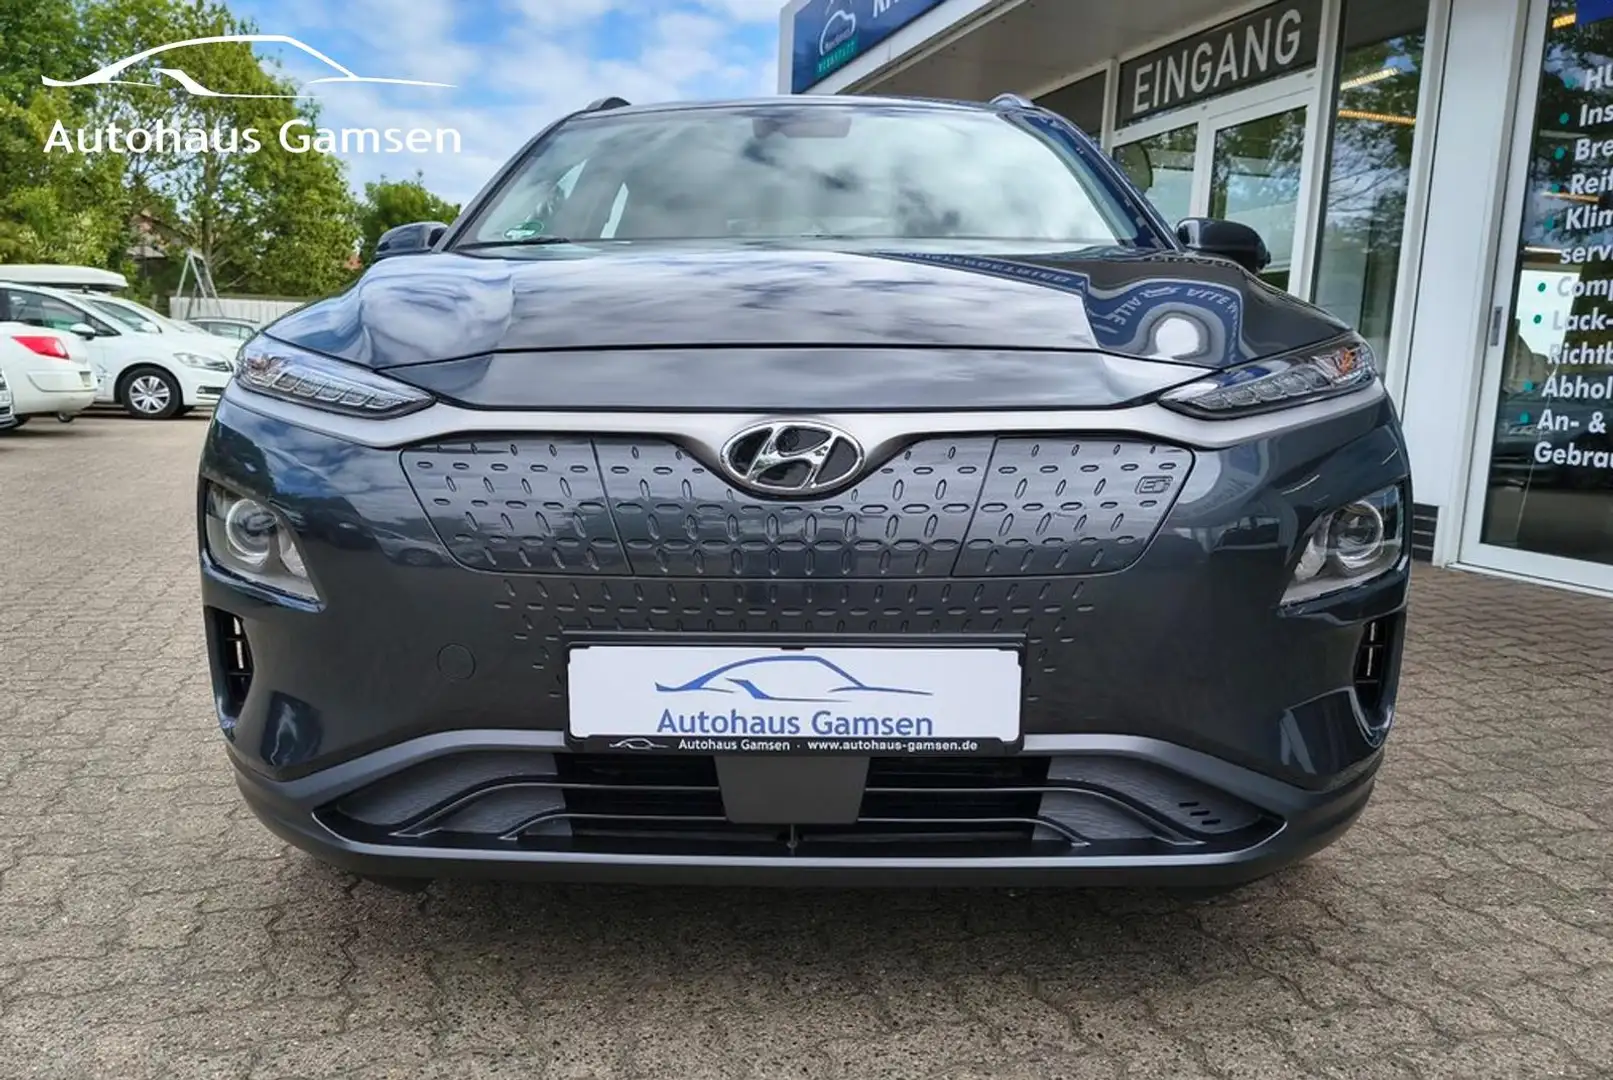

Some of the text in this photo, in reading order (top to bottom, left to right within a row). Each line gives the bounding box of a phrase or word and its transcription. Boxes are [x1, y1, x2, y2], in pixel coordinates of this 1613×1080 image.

[1132, 9, 1302, 114] EINGANG
[1579, 103, 1613, 127] Ins
[1574, 138, 1613, 161] Bre
[1552, 307, 1613, 331] Lack-
[1541, 375, 1613, 399] Abhol
[1536, 409, 1607, 433] An- &
[656, 708, 933, 736] Autohaus Gamsen
[678, 739, 978, 752] Autohaus Gamsen www.autohaus-gamsen.de
